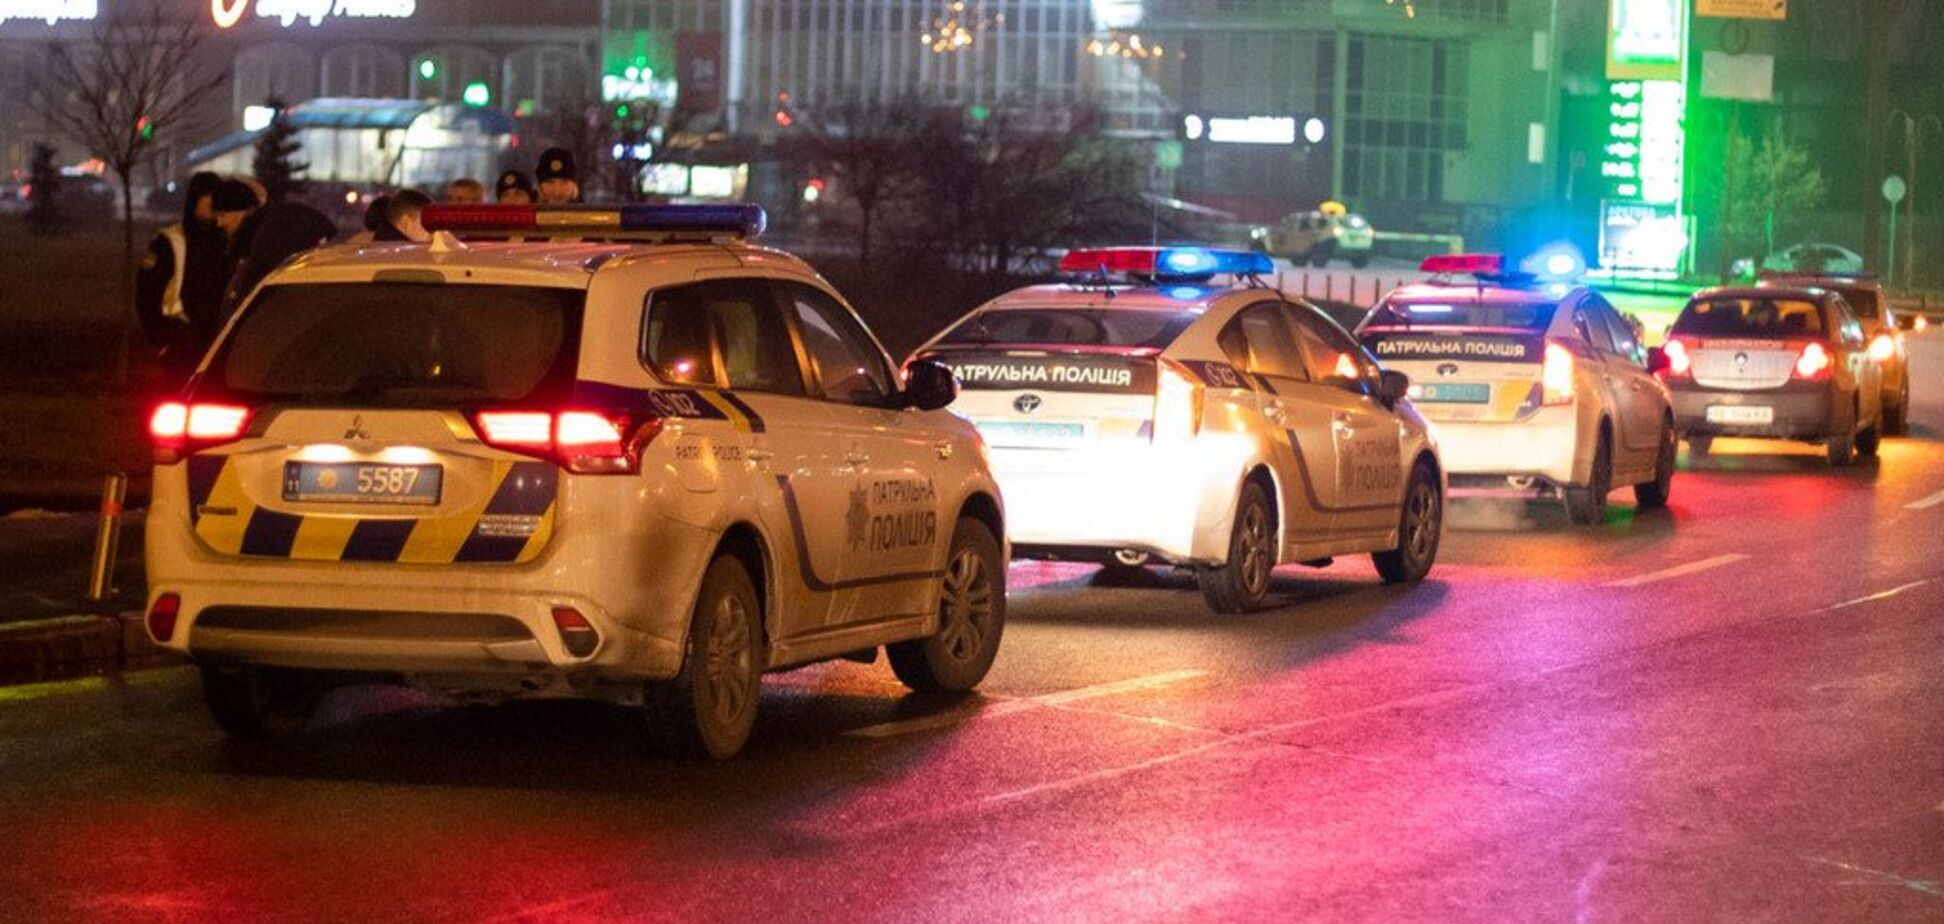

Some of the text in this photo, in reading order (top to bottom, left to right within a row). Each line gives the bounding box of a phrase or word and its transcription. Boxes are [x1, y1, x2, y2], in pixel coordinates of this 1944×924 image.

[1377, 340, 1526, 358] ПАТРУЛЬНА ПОЛІЦІЯ
[948, 364, 1132, 386] АТРУЛЬНА ПОЛІЦІЯ
[357, 467, 419, 494] 5587
[872, 477, 937, 504] ПАТРУЛЬНА
[869, 510, 937, 551] ПОЛІЦІЯ
